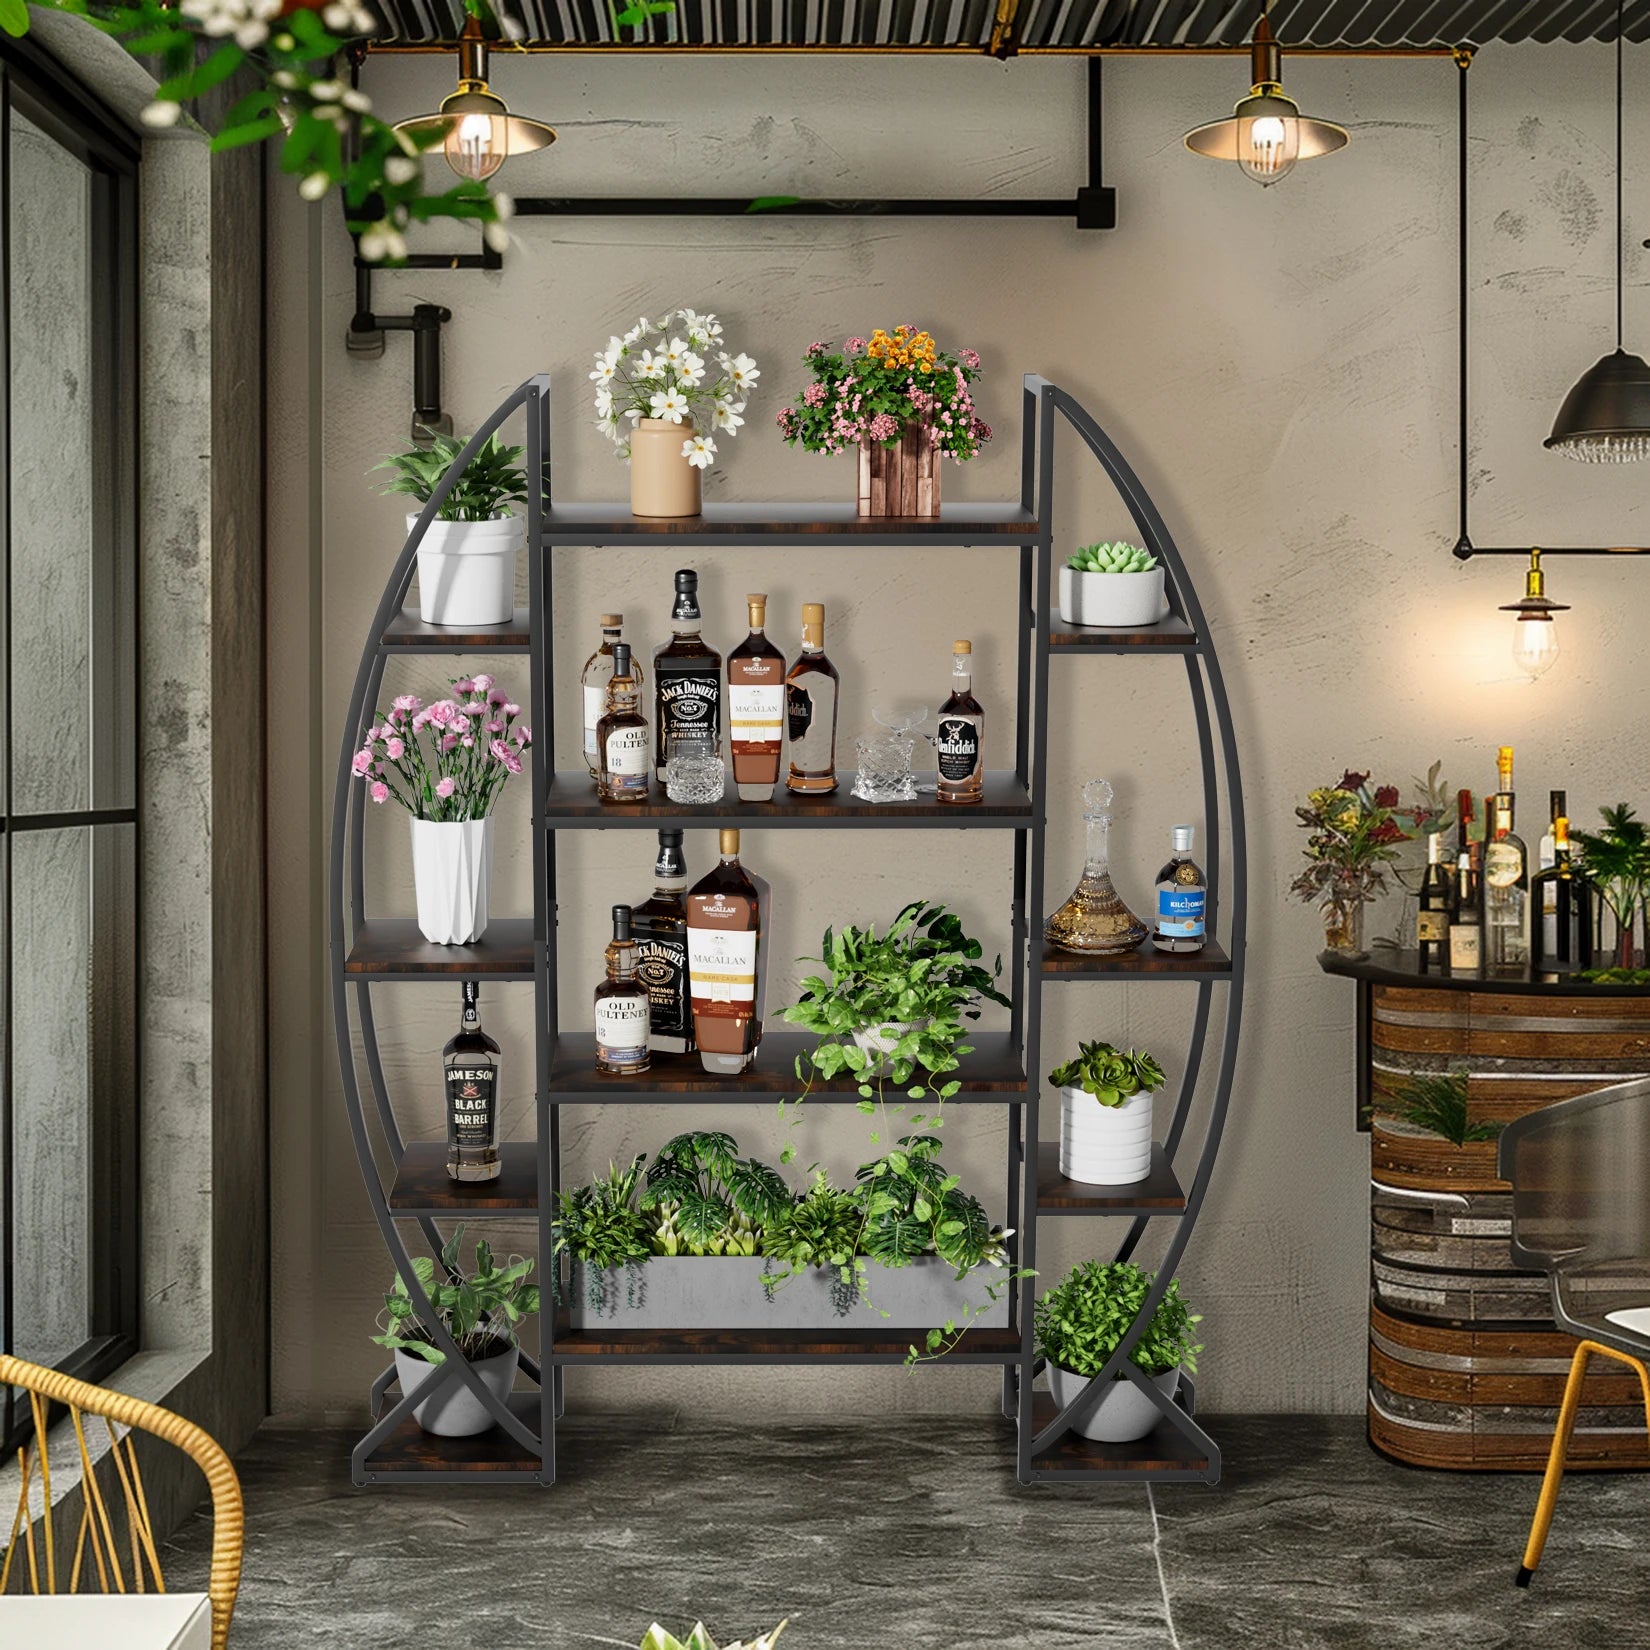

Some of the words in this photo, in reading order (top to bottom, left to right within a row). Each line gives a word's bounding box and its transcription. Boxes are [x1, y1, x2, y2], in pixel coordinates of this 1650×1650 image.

[661, 685, 684, 702] JACK
[683, 681, 719, 702] DANIEL'S
[735, 705, 778, 714] MACALLAN
[670, 719, 708, 728] Tennessee
[625, 731, 647, 740] OLD
[611, 758, 622, 768] 18
[702, 905, 736, 913] MACALLAN
[650, 942, 686, 969] DANIEL'S
[694, 954, 747, 966] MACALLAN
[608, 1002, 636, 1011] OLD
[650, 997, 675, 1006] ISKEY
[597, 1007, 648, 1020] PULTENEY
[447, 1070, 493, 1082] JAMESON
[454, 1098, 487, 1110] BLACK
[454, 1113, 488, 1125] BARREL
